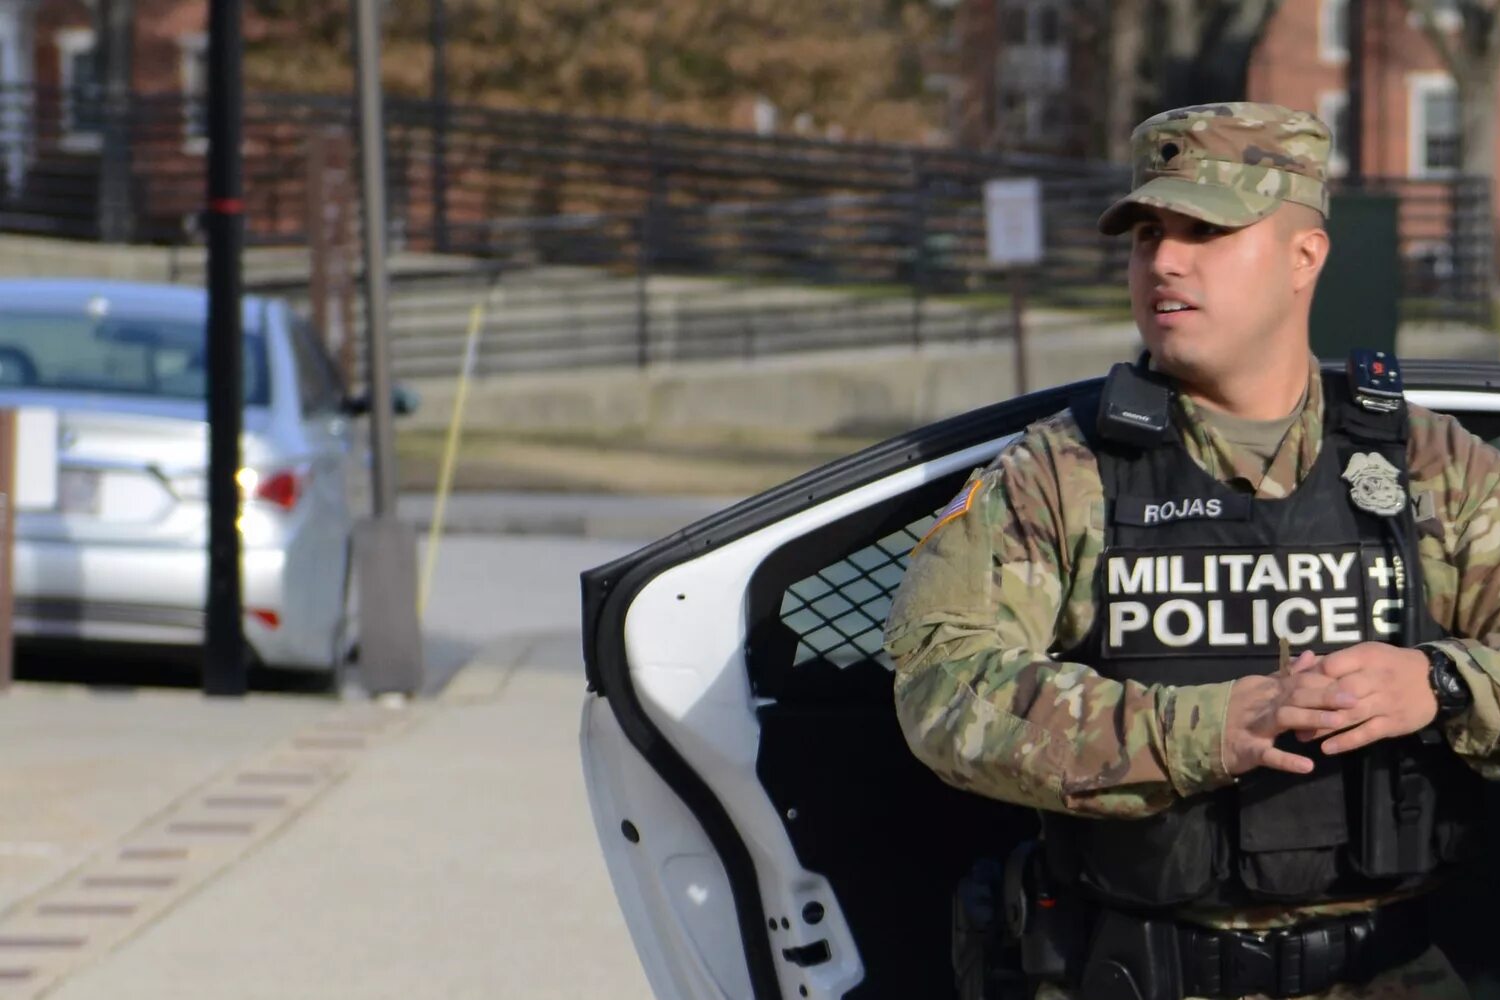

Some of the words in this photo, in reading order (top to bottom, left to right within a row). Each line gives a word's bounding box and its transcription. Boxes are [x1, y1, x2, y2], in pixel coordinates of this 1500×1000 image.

[1144, 498, 1222, 524] ROJAS
[1107, 552, 1356, 595] MILITARY
[1109, 597, 1363, 648] POLICE
